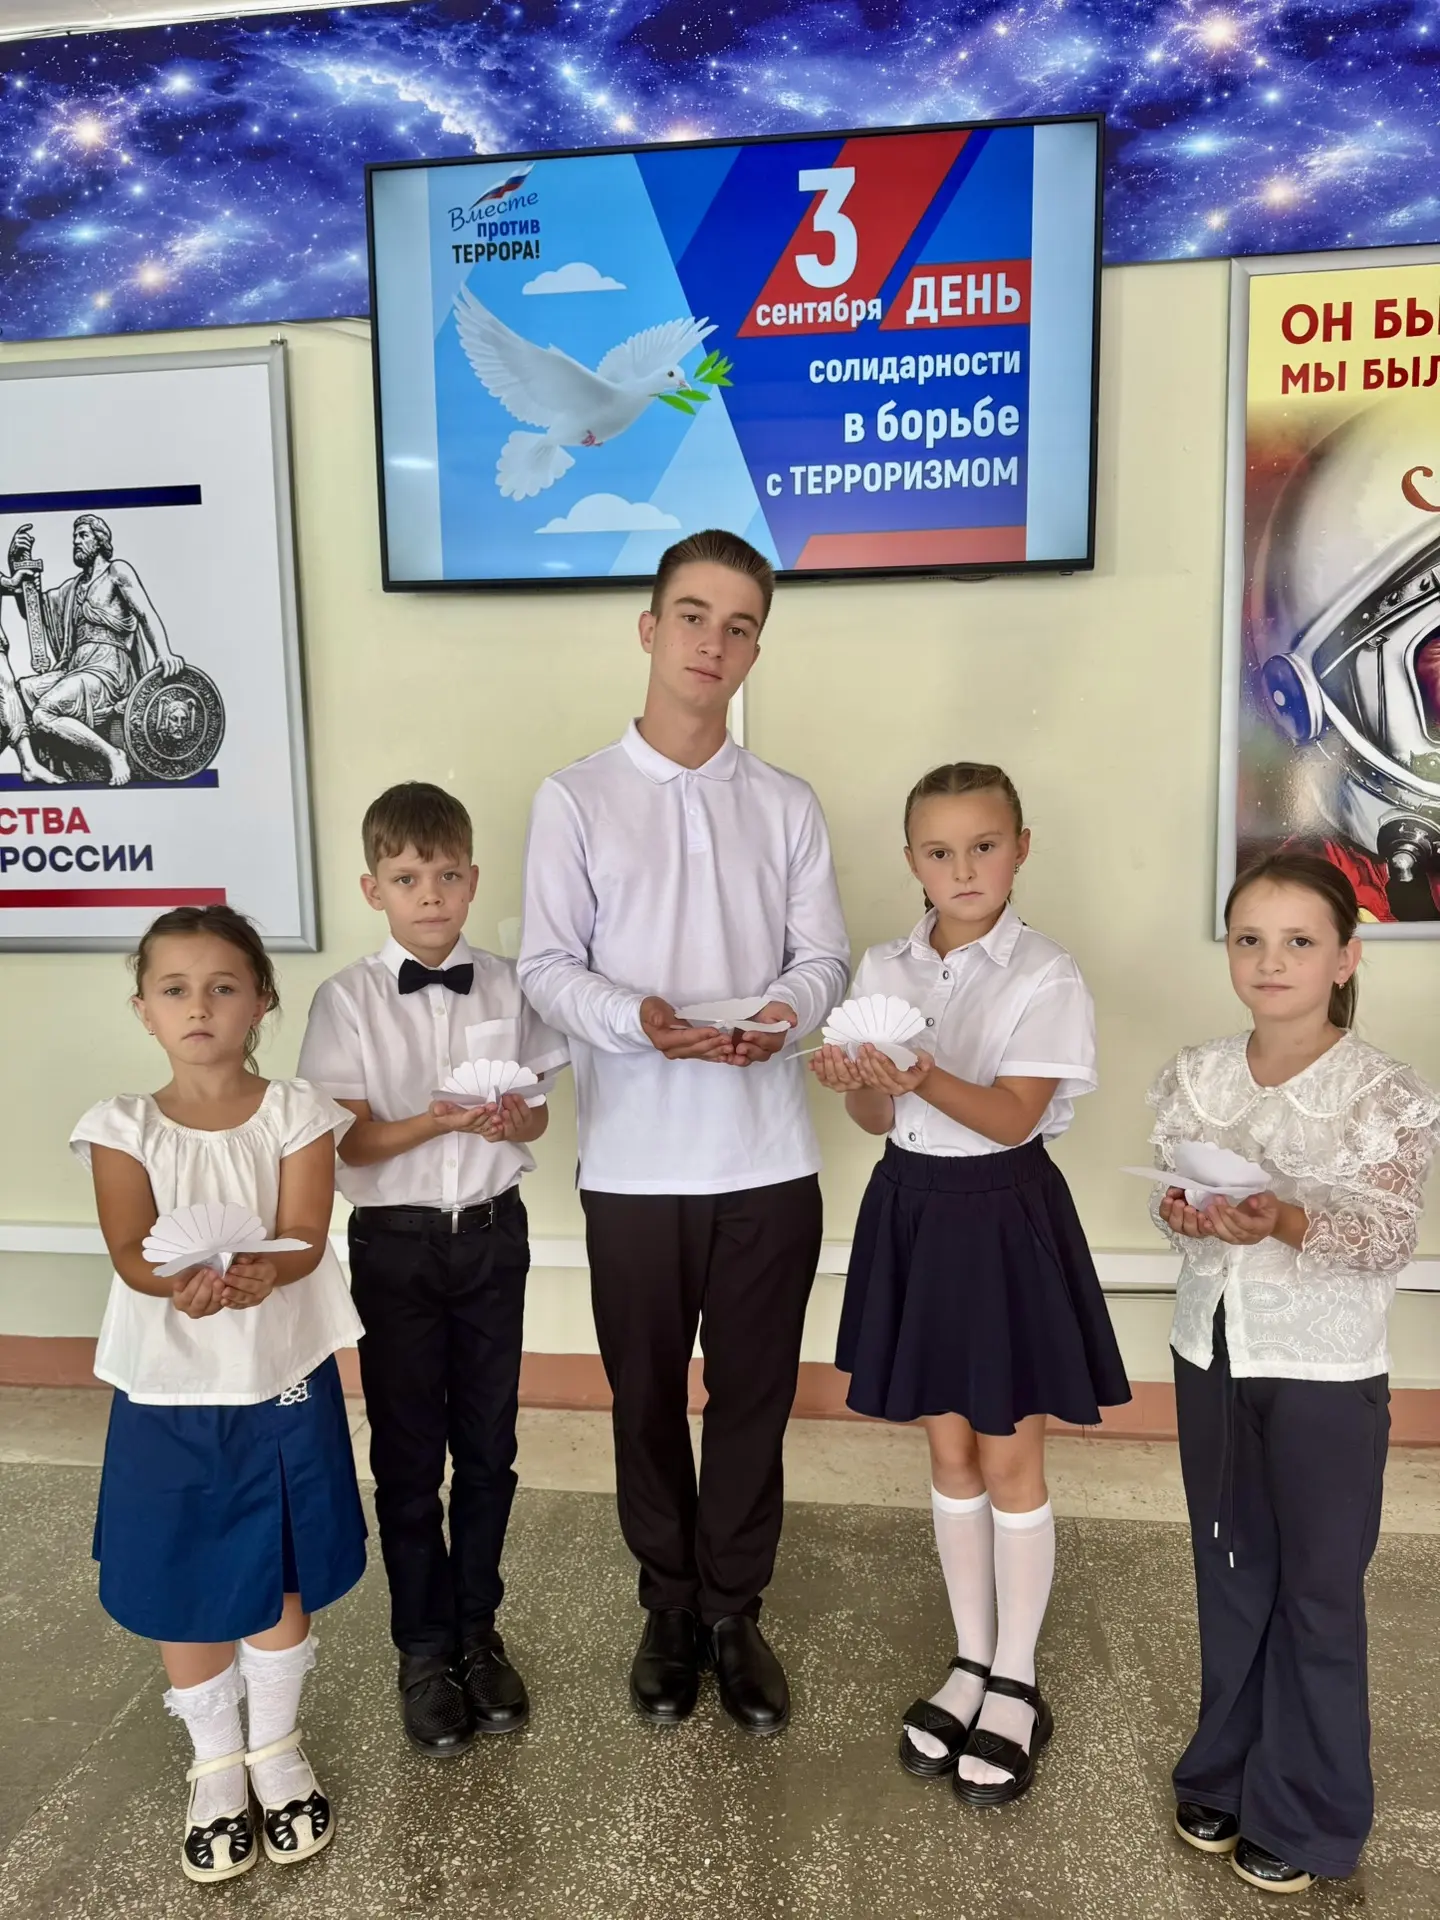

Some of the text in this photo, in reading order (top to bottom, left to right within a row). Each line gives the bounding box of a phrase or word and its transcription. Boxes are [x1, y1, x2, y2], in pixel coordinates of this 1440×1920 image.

[448, 192, 539, 231] Вместе
[477, 219, 540, 240] против
[795, 166, 858, 288] 3
[452, 240, 541, 264] ТЕРРОРА!
[756, 293, 882, 328] сентября
[905, 272, 1021, 325] ДЕНЬ
[1281, 301, 1353, 345] ОН
[809, 350, 1021, 386] солидарности
[1281, 360, 1347, 395] МЫ
[844, 395, 1020, 449] в борьбе
[766, 456, 1019, 496] с ТЕРРОРИЗМОМ
[0, 843, 154, 873] РОССИИ
